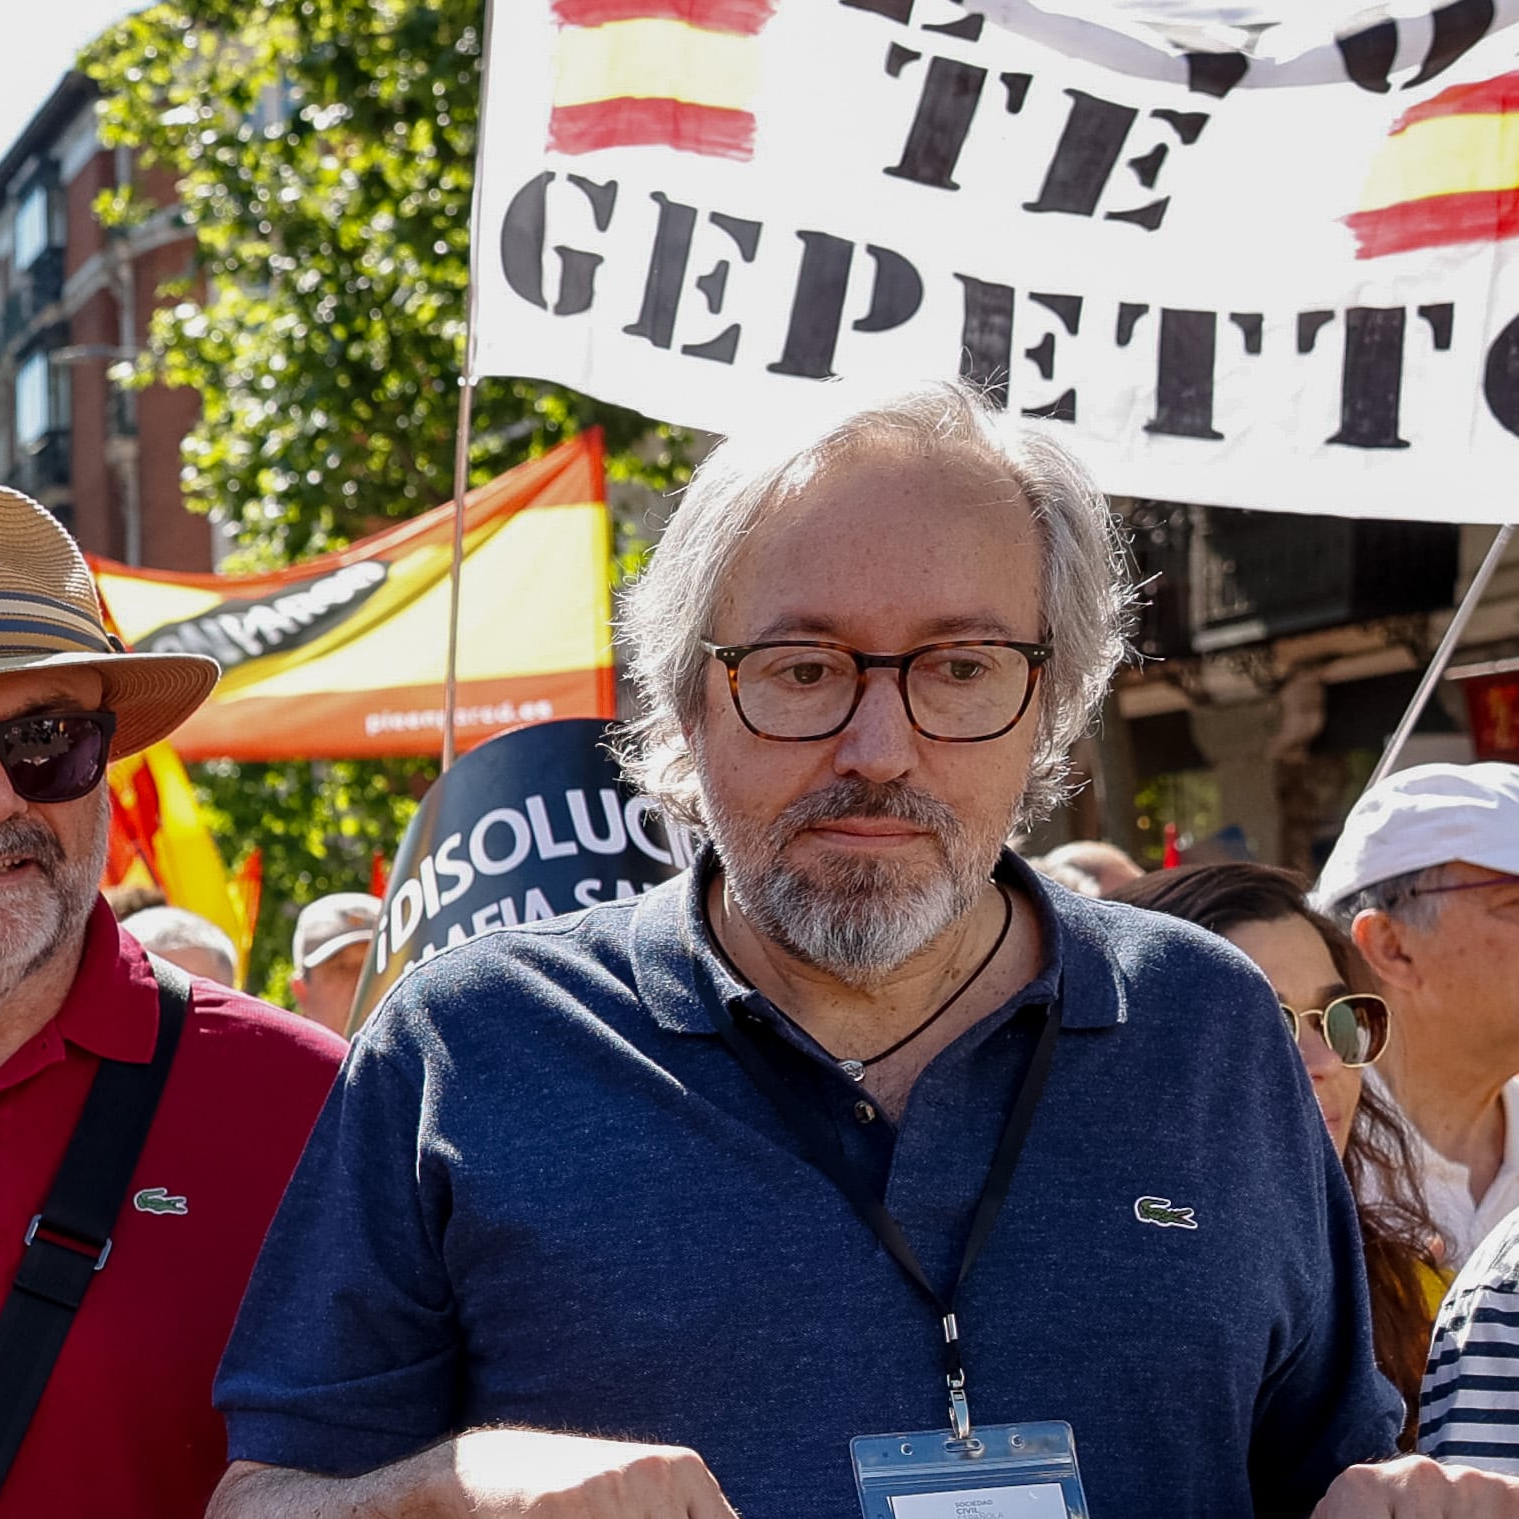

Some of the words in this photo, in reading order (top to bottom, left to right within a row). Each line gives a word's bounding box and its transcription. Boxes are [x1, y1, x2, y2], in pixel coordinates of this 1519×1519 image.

[883, 42, 1210, 232] TE
[955, 1499, 994, 1508] SOCIEDAD
[956, 1507, 981, 1515] CIVIL
